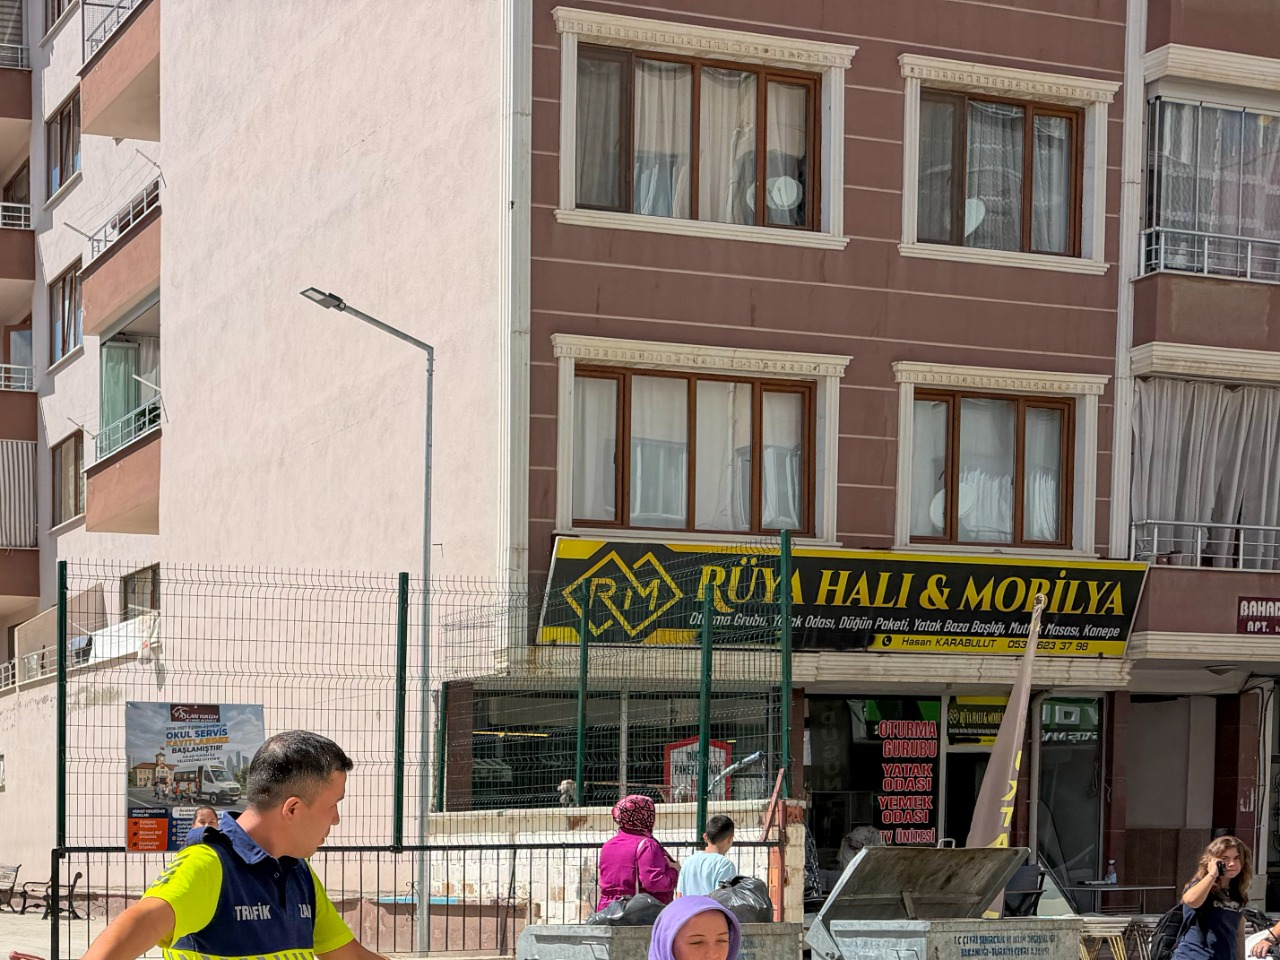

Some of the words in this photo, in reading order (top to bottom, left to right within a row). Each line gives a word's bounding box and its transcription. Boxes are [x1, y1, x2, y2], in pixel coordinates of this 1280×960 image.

[814, 569, 916, 610] HALI
[919, 574, 951, 610] &
[956, 569, 1125, 616] MOBİLYA
[805, 615, 836, 630] Odası,
[839, 616, 873, 632] Düğün
[875, 618, 911, 632] Paketi,
[913, 619, 943, 632] Yatak
[944, 620, 970, 633] Baza
[971, 621, 1006, 636] Başlığı,
[1045, 623, 1080, 638] Masası,
[1083, 624, 1121, 640] Kanepe
[1247, 620, 1270, 633] APT.
[901, 636, 932, 647] Hasan
[935, 637, 997, 649] KARABULUT
[1037, 641, 1057, 651] 623
[1059, 642, 1073, 651] 37
[1075, 642, 1089, 652] 98
[165, 730, 193, 740] OKUL
[194, 728, 228, 738] SERVİS
[878, 719, 938, 739] OTURMA
[171, 744, 224, 754] BAŞLAMIŞTIR!
[882, 739, 938, 758] GURUBU
[882, 763, 933, 777] YATAK
[882, 777, 933, 792] ODASI
[878, 795, 933, 810] YEMEK
[881, 809, 929, 824] ODASI
[879, 830, 893, 844] TV
[895, 827, 936, 844] ÜNİTESİ
